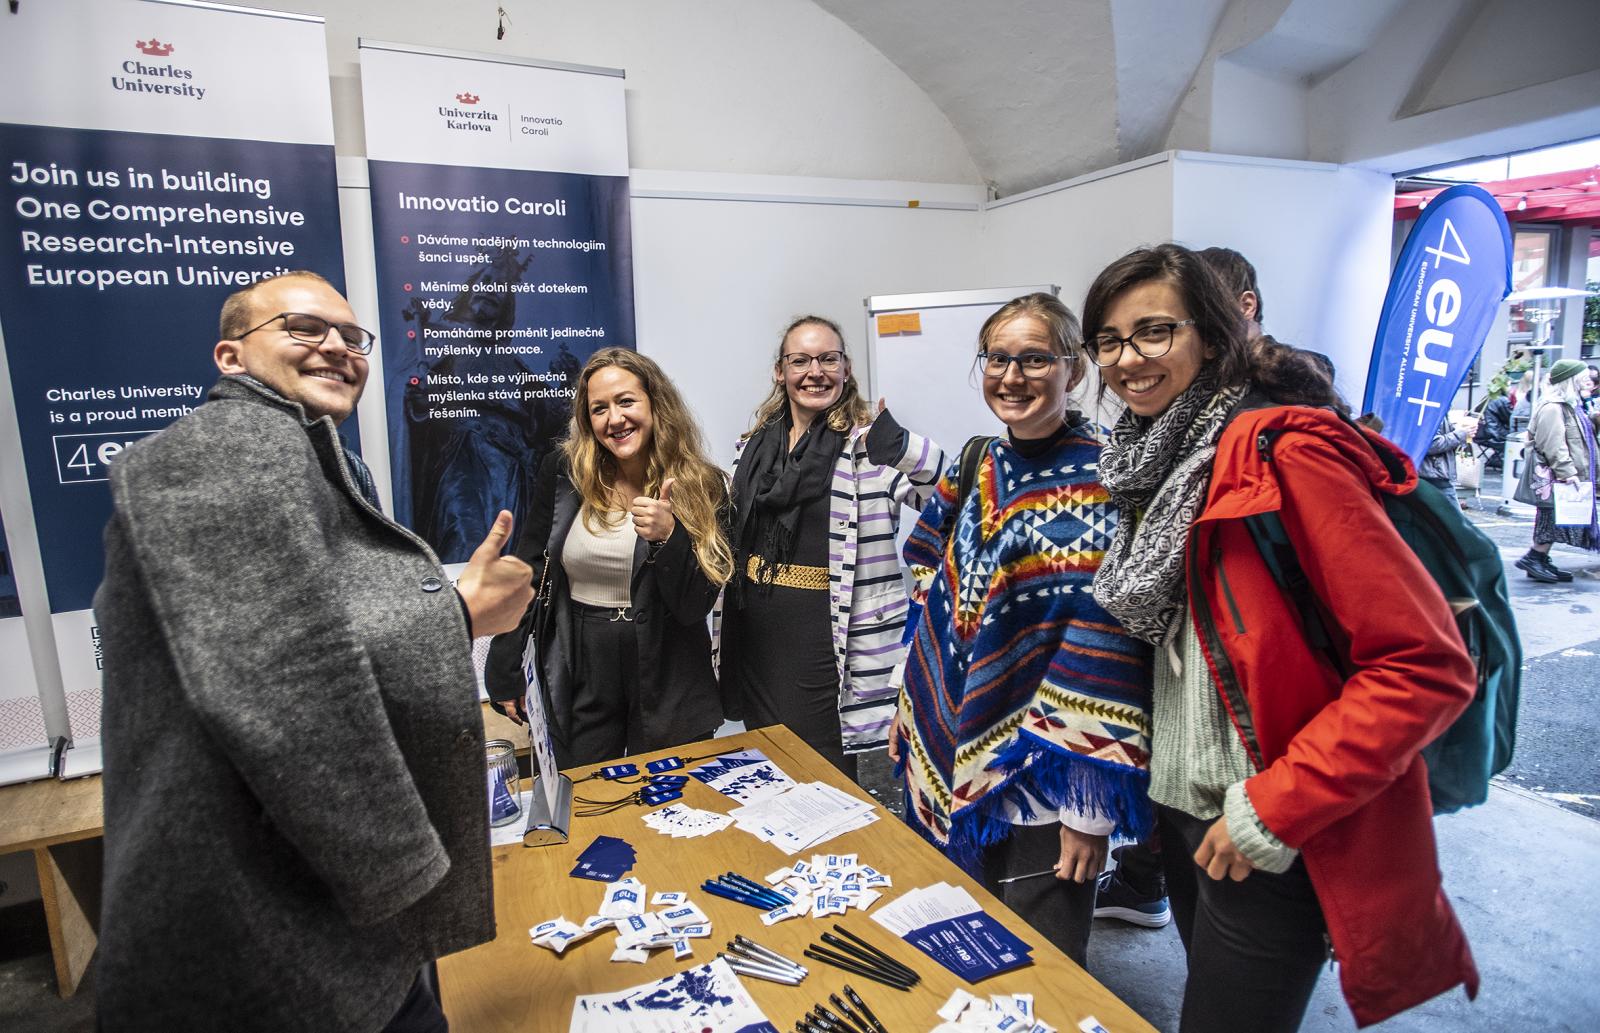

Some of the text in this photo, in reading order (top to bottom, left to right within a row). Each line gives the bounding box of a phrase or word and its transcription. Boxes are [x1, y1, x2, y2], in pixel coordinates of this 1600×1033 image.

[122, 60, 192, 80] Charles
[112, 76, 206, 100] University
[438, 107, 498, 121] Univerzita
[520, 115, 563, 126] Innovatio
[447, 120, 492, 132] Karlova
[522, 126, 549, 136] Caroli
[11, 162, 271, 199] Join us in building
[16, 197, 304, 228] One Comprehensive
[399, 192, 566, 216] Innovatio Caroli
[21, 231, 295, 256] Research-Intensive
[418, 234, 606, 252] Dáváme nadějným technologiím
[418, 251, 492, 266] šanci uspět.
[27, 264, 168, 290] European
[420, 282, 588, 294] Měníme okolní svět dotekem
[422, 299, 454, 311] vědy.
[1396, 261, 1428, 398] EUROPEAN UNIVERSITY ALLIANCE
[1408, 218, 1471, 426] 4eu+
[424, 326, 605, 340] Pomáháme proměnit jedinečné
[425, 344, 482, 358] myšlenky
[494, 344, 544, 354] inovace.
[427, 372, 566, 386] Místo, kde se výjimečná
[46, 384, 203, 402] Charles University
[428, 392, 486, 404] myšlenka
[488, 388, 521, 400] stává
[50, 411, 64, 423] is
[70, 412, 81, 422] a
[86, 407, 137, 424] proud
[430, 407, 480, 418] řešením.
[67, 441, 133, 476] 4e
